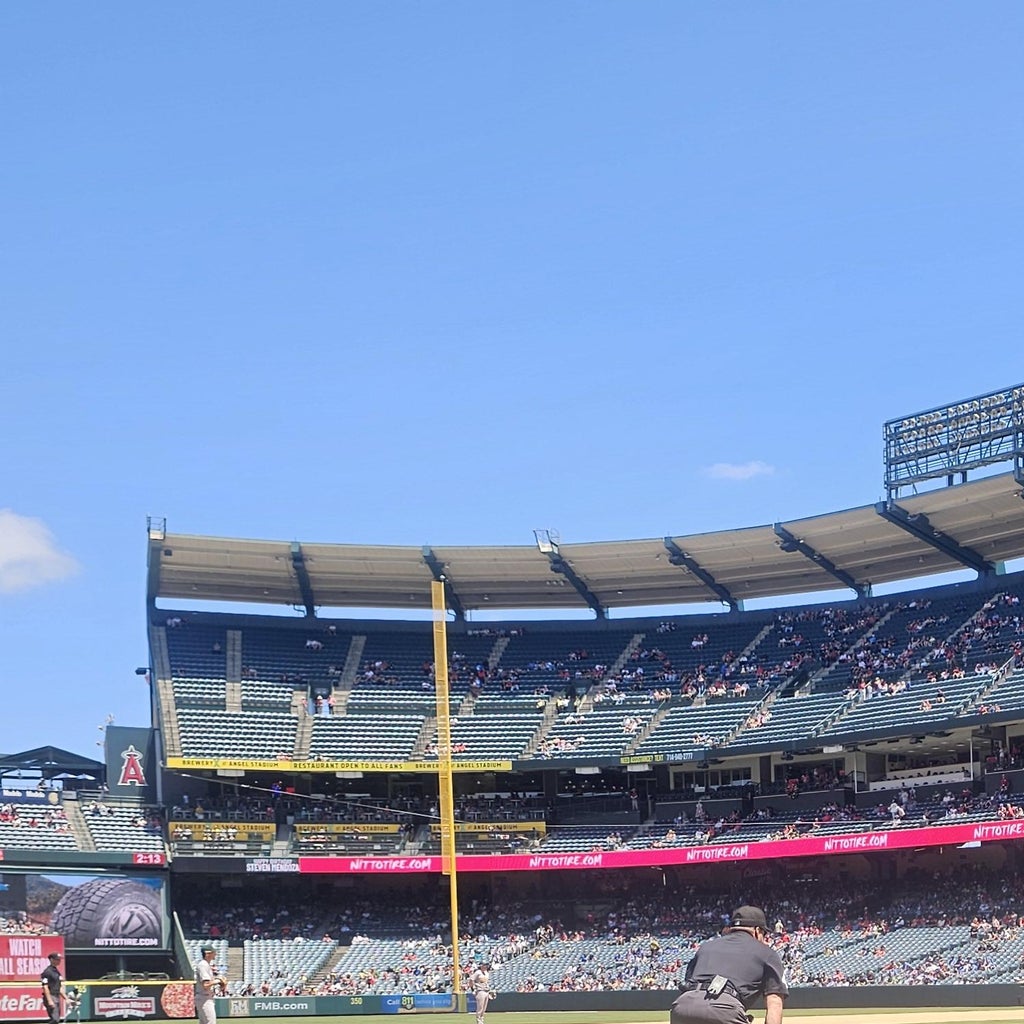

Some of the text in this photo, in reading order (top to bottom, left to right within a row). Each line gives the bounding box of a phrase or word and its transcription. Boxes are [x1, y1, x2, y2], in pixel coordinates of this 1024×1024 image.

[824, 834, 888, 850] NITTOTIRE.COM
[687, 845, 748, 860] NITTOTIRE.COM
[136, 854, 161, 863] 2:13
[529, 855, 602, 867] NITTOTIRE.COM
[246, 863, 271, 871] STEVEN
[350, 859, 431, 870] NITTOTIRE.COM
[9, 938, 42, 956] WATCH
[95, 938, 158, 947] NITTOTIRE.COM
[350, 997, 363, 1005] 350
[401, 996, 413, 1005] 811
[254, 1002, 308, 1010] FMB.com
